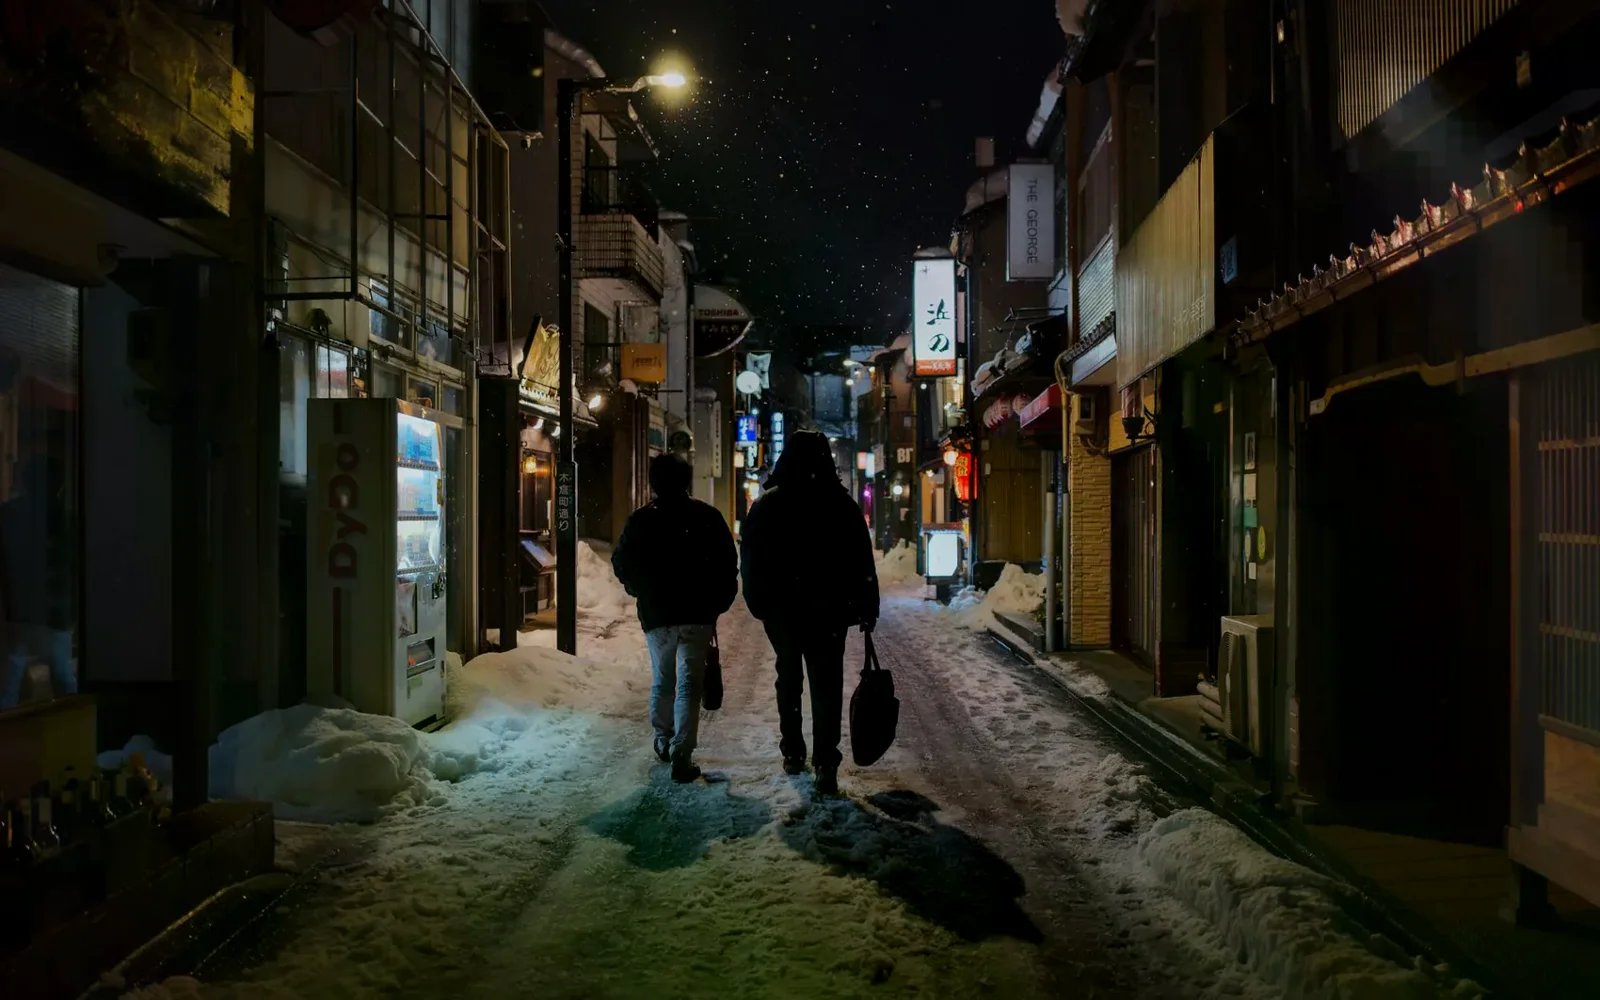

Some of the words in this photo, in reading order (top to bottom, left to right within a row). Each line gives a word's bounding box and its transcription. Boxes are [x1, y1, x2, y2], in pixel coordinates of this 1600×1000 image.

[1027, 179, 1037, 202] THE
[1027, 209, 1038, 264] GEORGE
[698, 308, 739, 316] TOSHIBA
[926, 298, 951, 353] 浜の
[328, 442, 367, 578] DyDo
